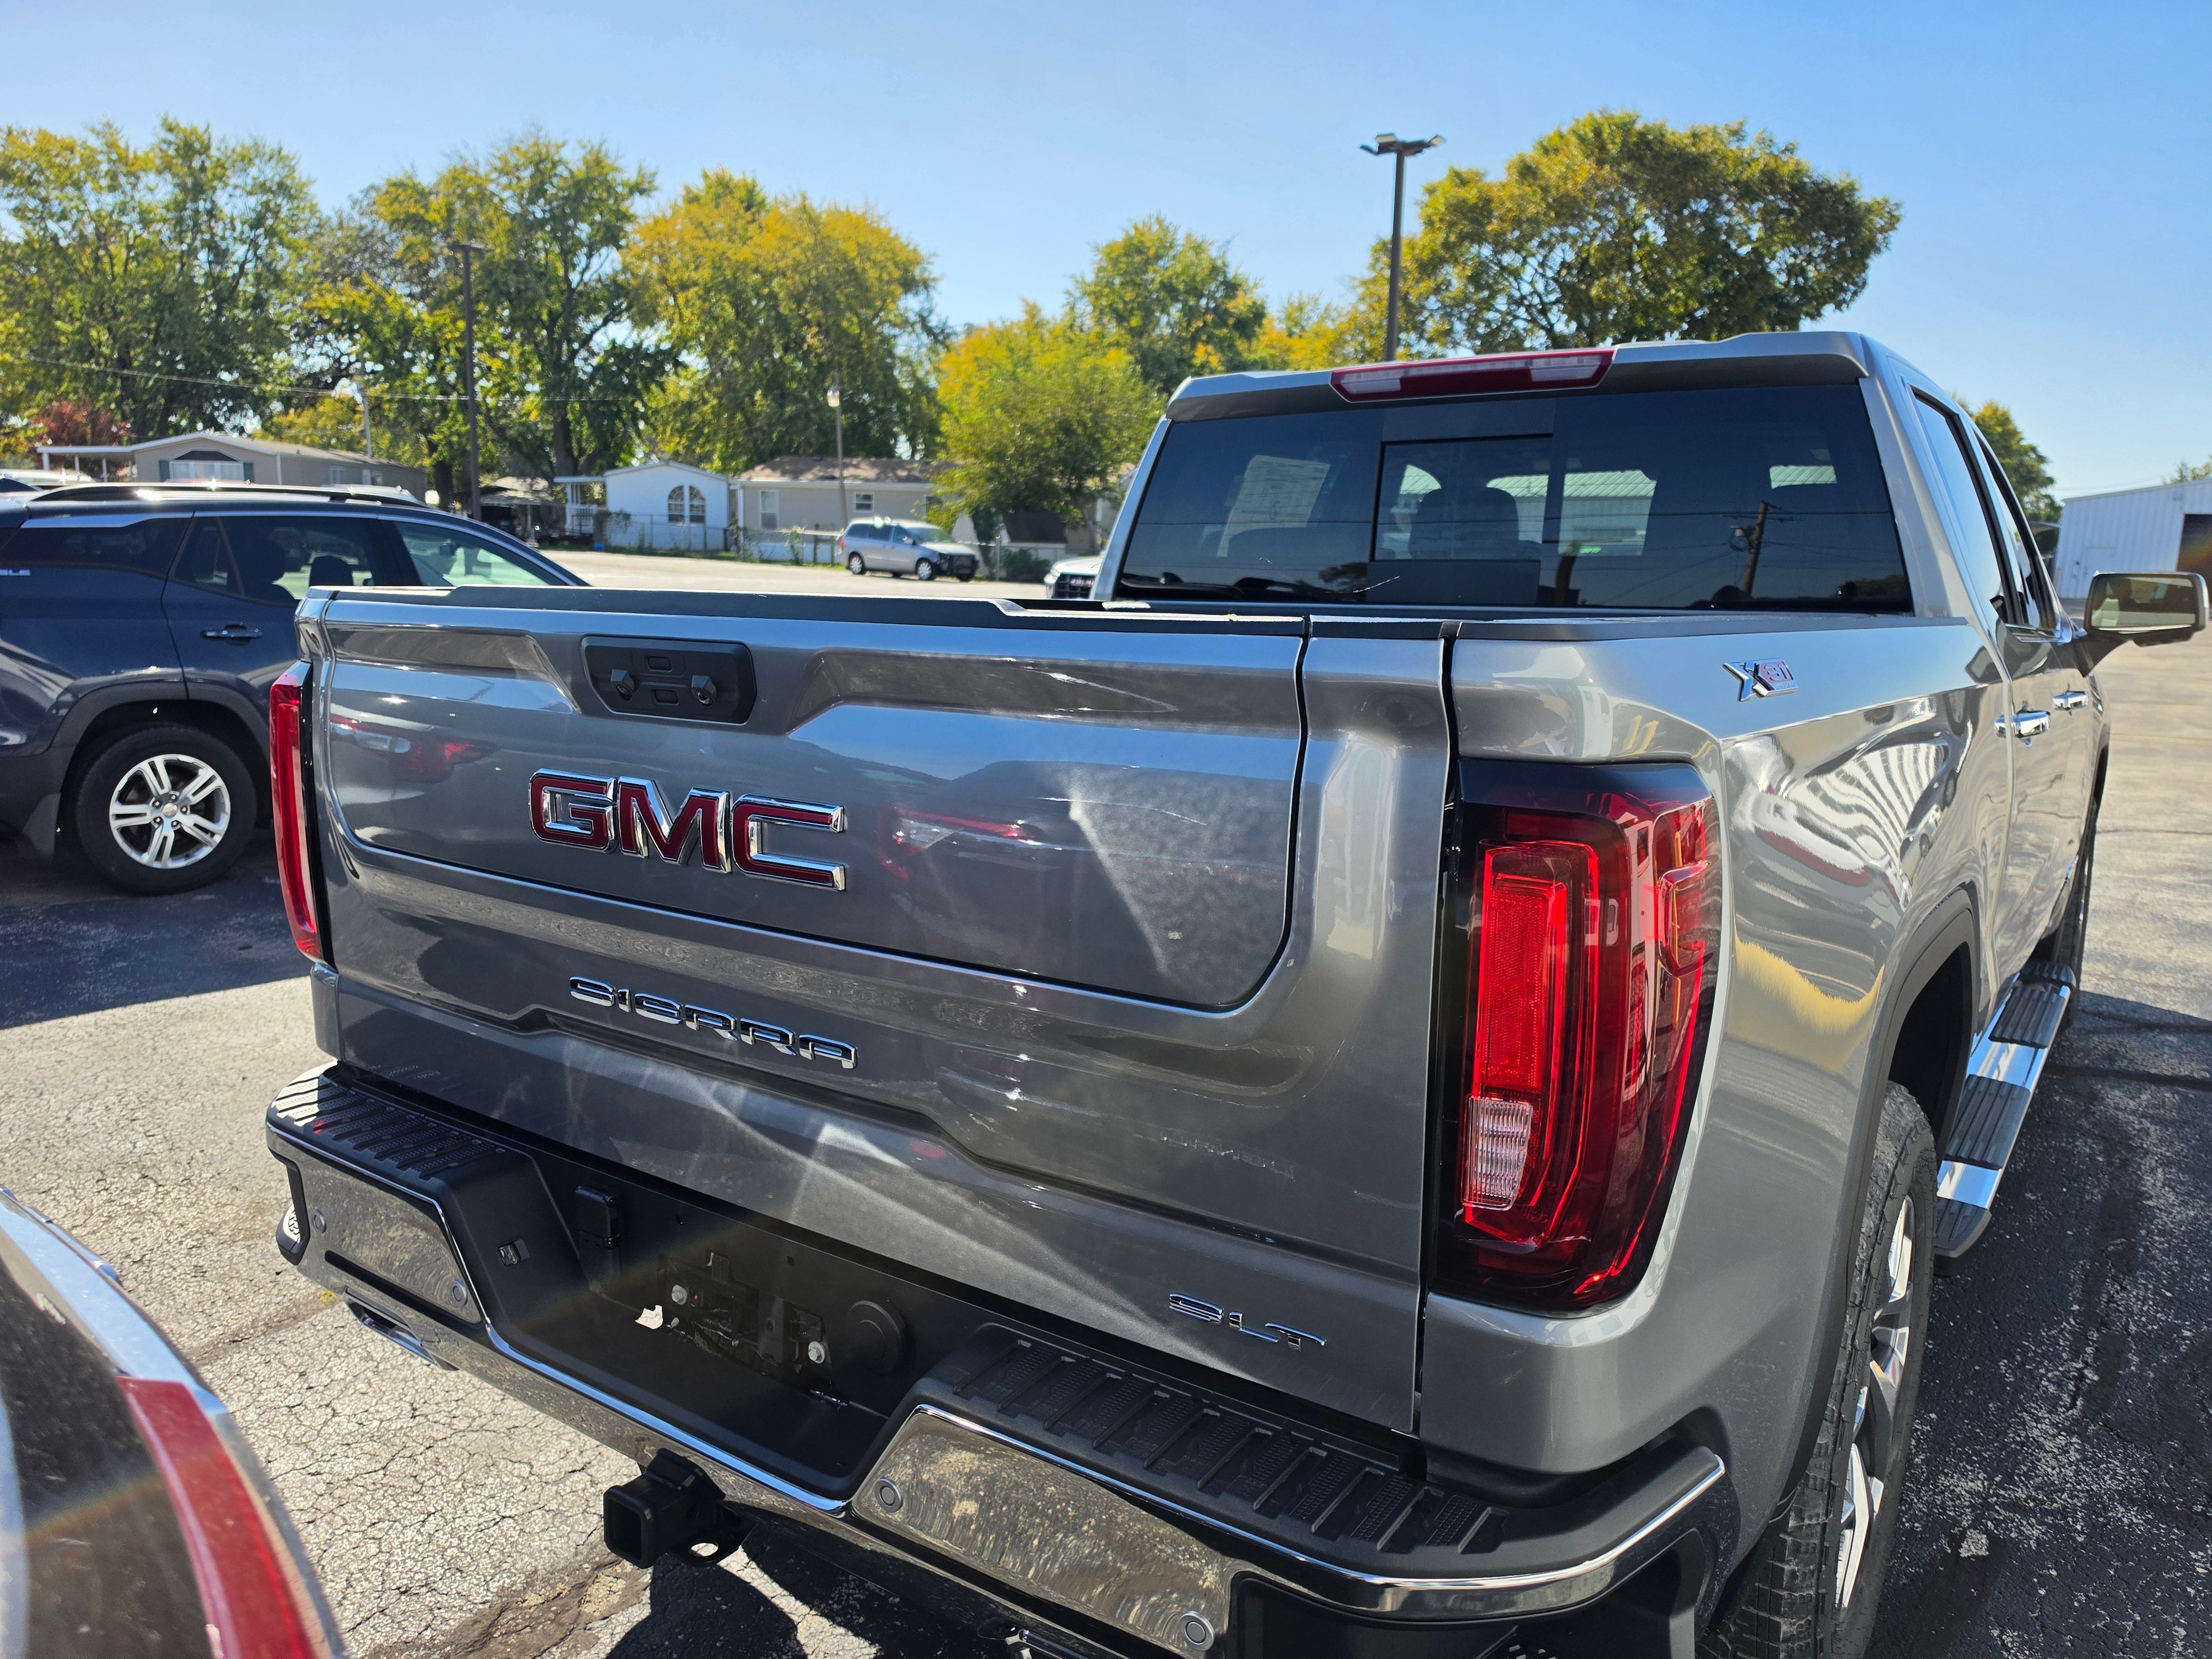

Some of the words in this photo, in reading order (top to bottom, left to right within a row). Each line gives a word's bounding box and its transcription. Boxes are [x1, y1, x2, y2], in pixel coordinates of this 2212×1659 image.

[1720, 658, 1798, 701] X31
[529, 768, 847, 891] GMC
[570, 976, 858, 1068] SIERRA
[1169, 1292, 1326, 1352] SLT
